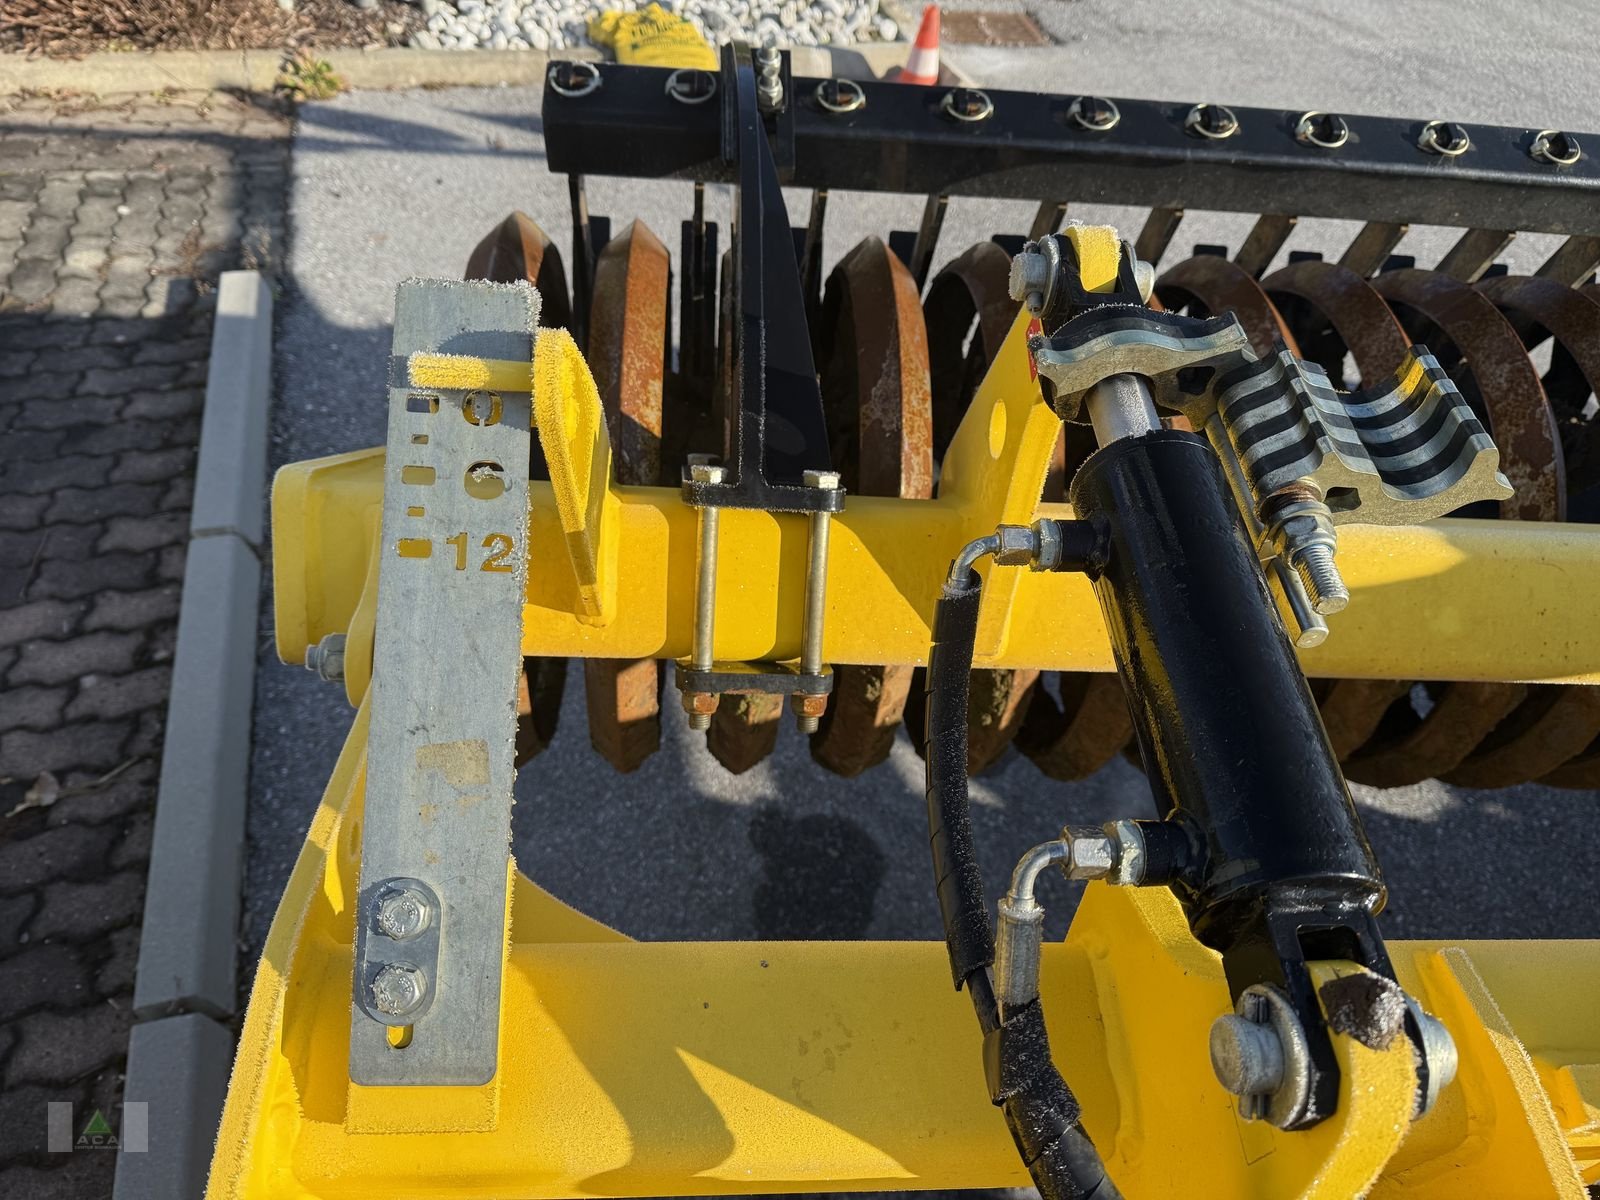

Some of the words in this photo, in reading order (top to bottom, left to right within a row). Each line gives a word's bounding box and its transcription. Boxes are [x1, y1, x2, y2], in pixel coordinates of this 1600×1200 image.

[462, 391, 504, 426] 0
[464, 459, 507, 500] 6
[446, 532, 514, 573] 12
